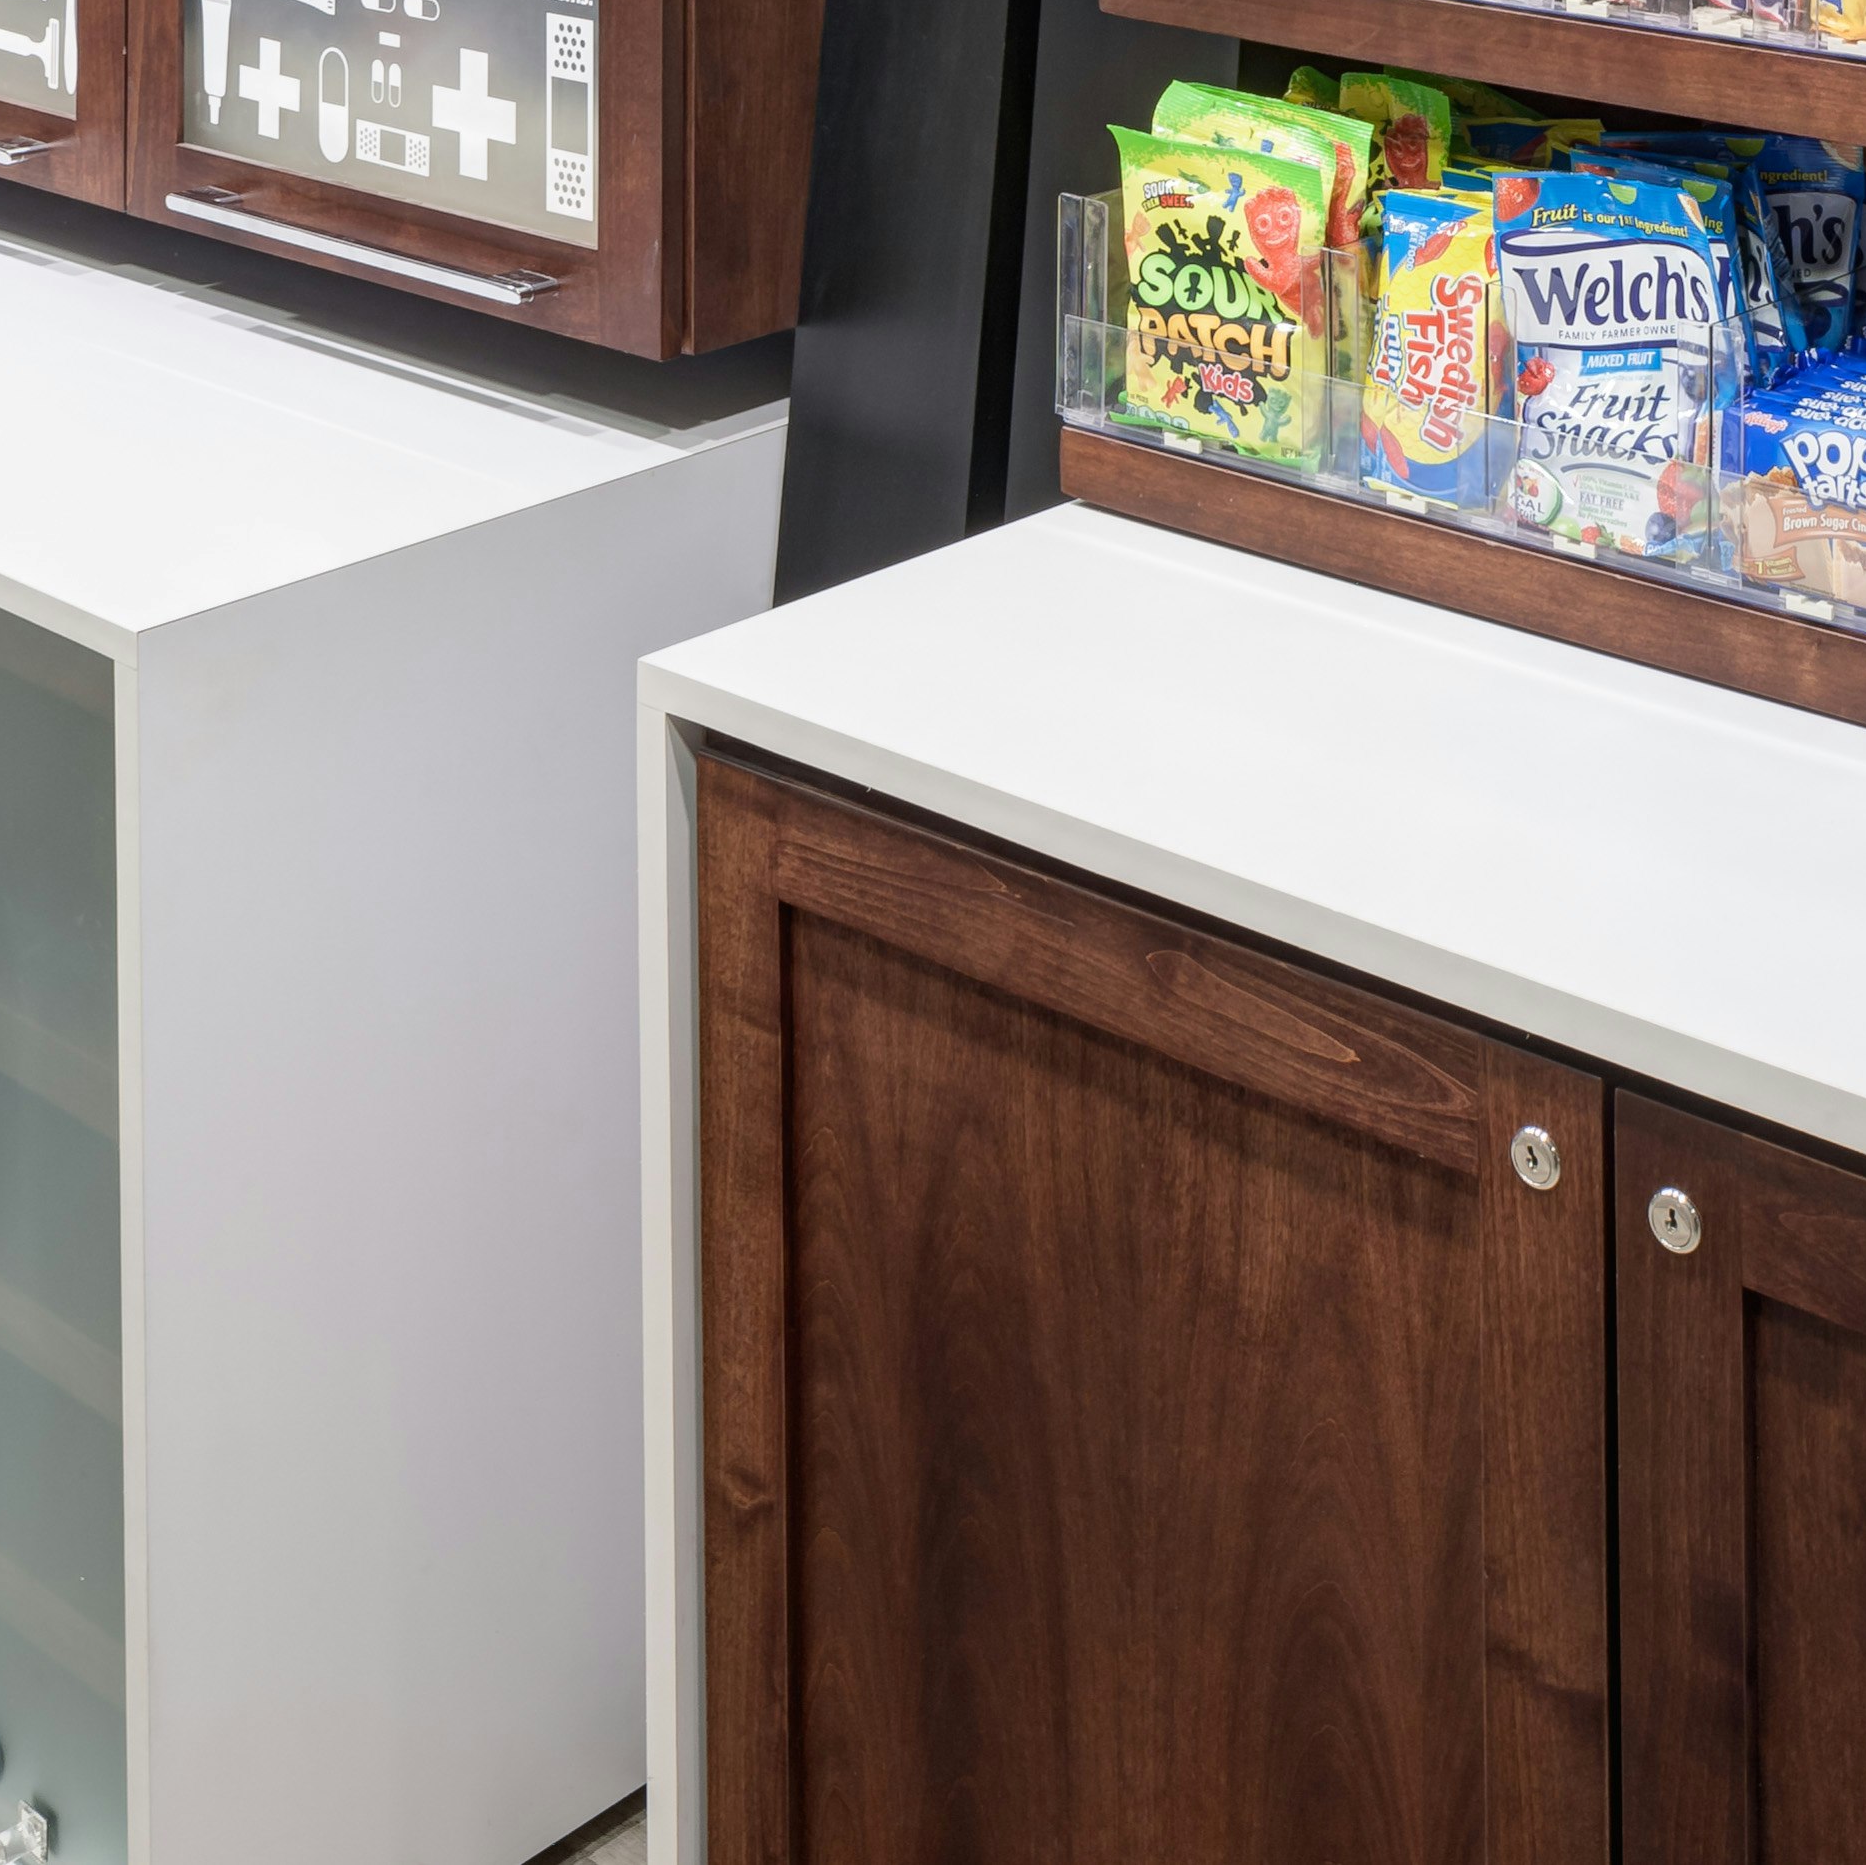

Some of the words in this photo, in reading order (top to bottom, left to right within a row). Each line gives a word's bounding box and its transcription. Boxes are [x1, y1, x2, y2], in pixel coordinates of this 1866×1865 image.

[1144, 181, 1174, 198] SOUR
[1531, 205, 1578, 228] Fruit
[1583, 209, 1593, 223] is
[1596, 212, 1614, 224] our
[1635, 217, 1689, 238] Ingredient!
[1137, 253, 1285, 322] SOUR
[1512, 255, 1710, 326] Welch's
[1136, 307, 1292, 375] PATCH
[1587, 353, 1626, 368] MIXED
[1628, 351, 1656, 367] FRUIT
[1398, 312, 1436, 409] Fish
[1420, 274, 1483, 451] Swedish
[1198, 364, 1255, 402] Kids
[1567, 382, 1671, 420] Fruit
[1783, 513, 1817, 531] Brown
[1819, 515, 1849, 532] Sugar
